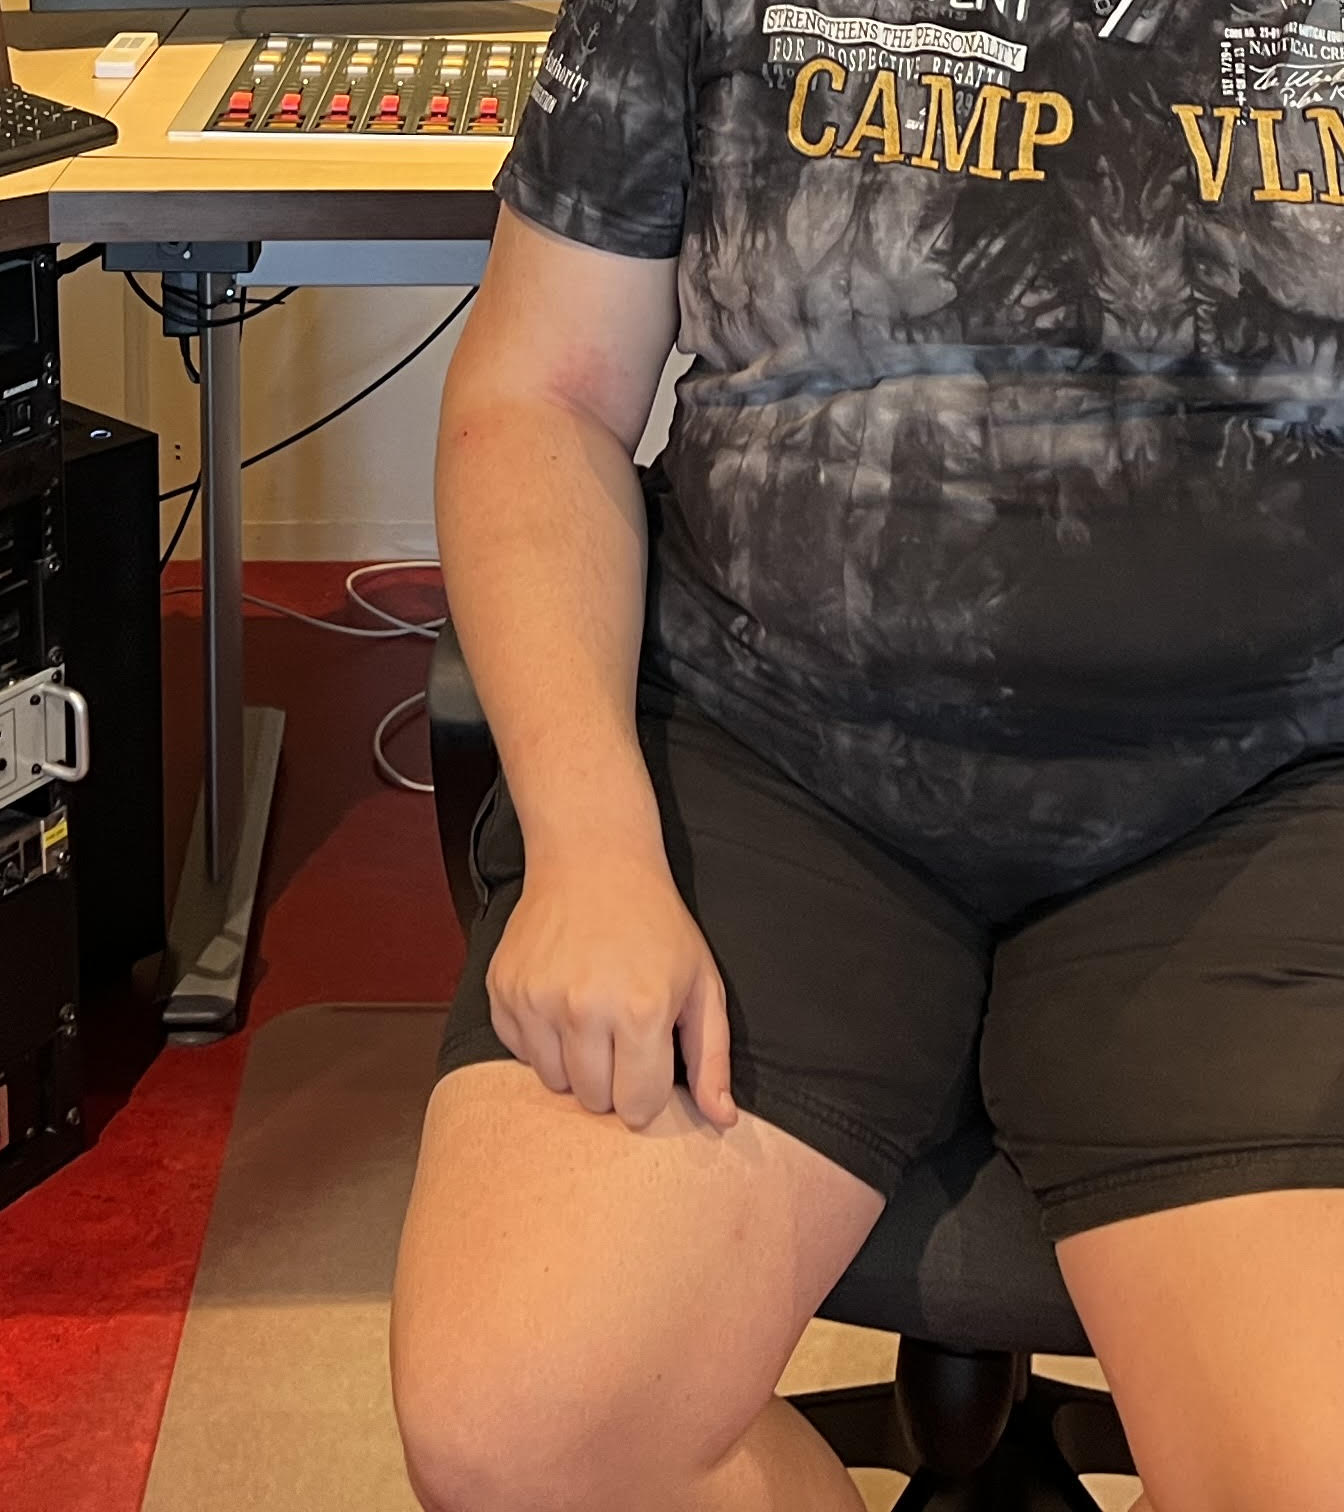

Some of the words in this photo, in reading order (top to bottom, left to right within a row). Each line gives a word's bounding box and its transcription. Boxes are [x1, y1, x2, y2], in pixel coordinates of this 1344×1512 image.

[766, 8, 878, 40] STRENGTHENS
[882, 27, 913, 48] THE
[914, 27, 1022, 66] PERSONALITY
[773, 37, 805, 61] FOR
[1248, 37, 1318, 60] NAUTICAL
[787, 58, 1075, 182] CAMP
